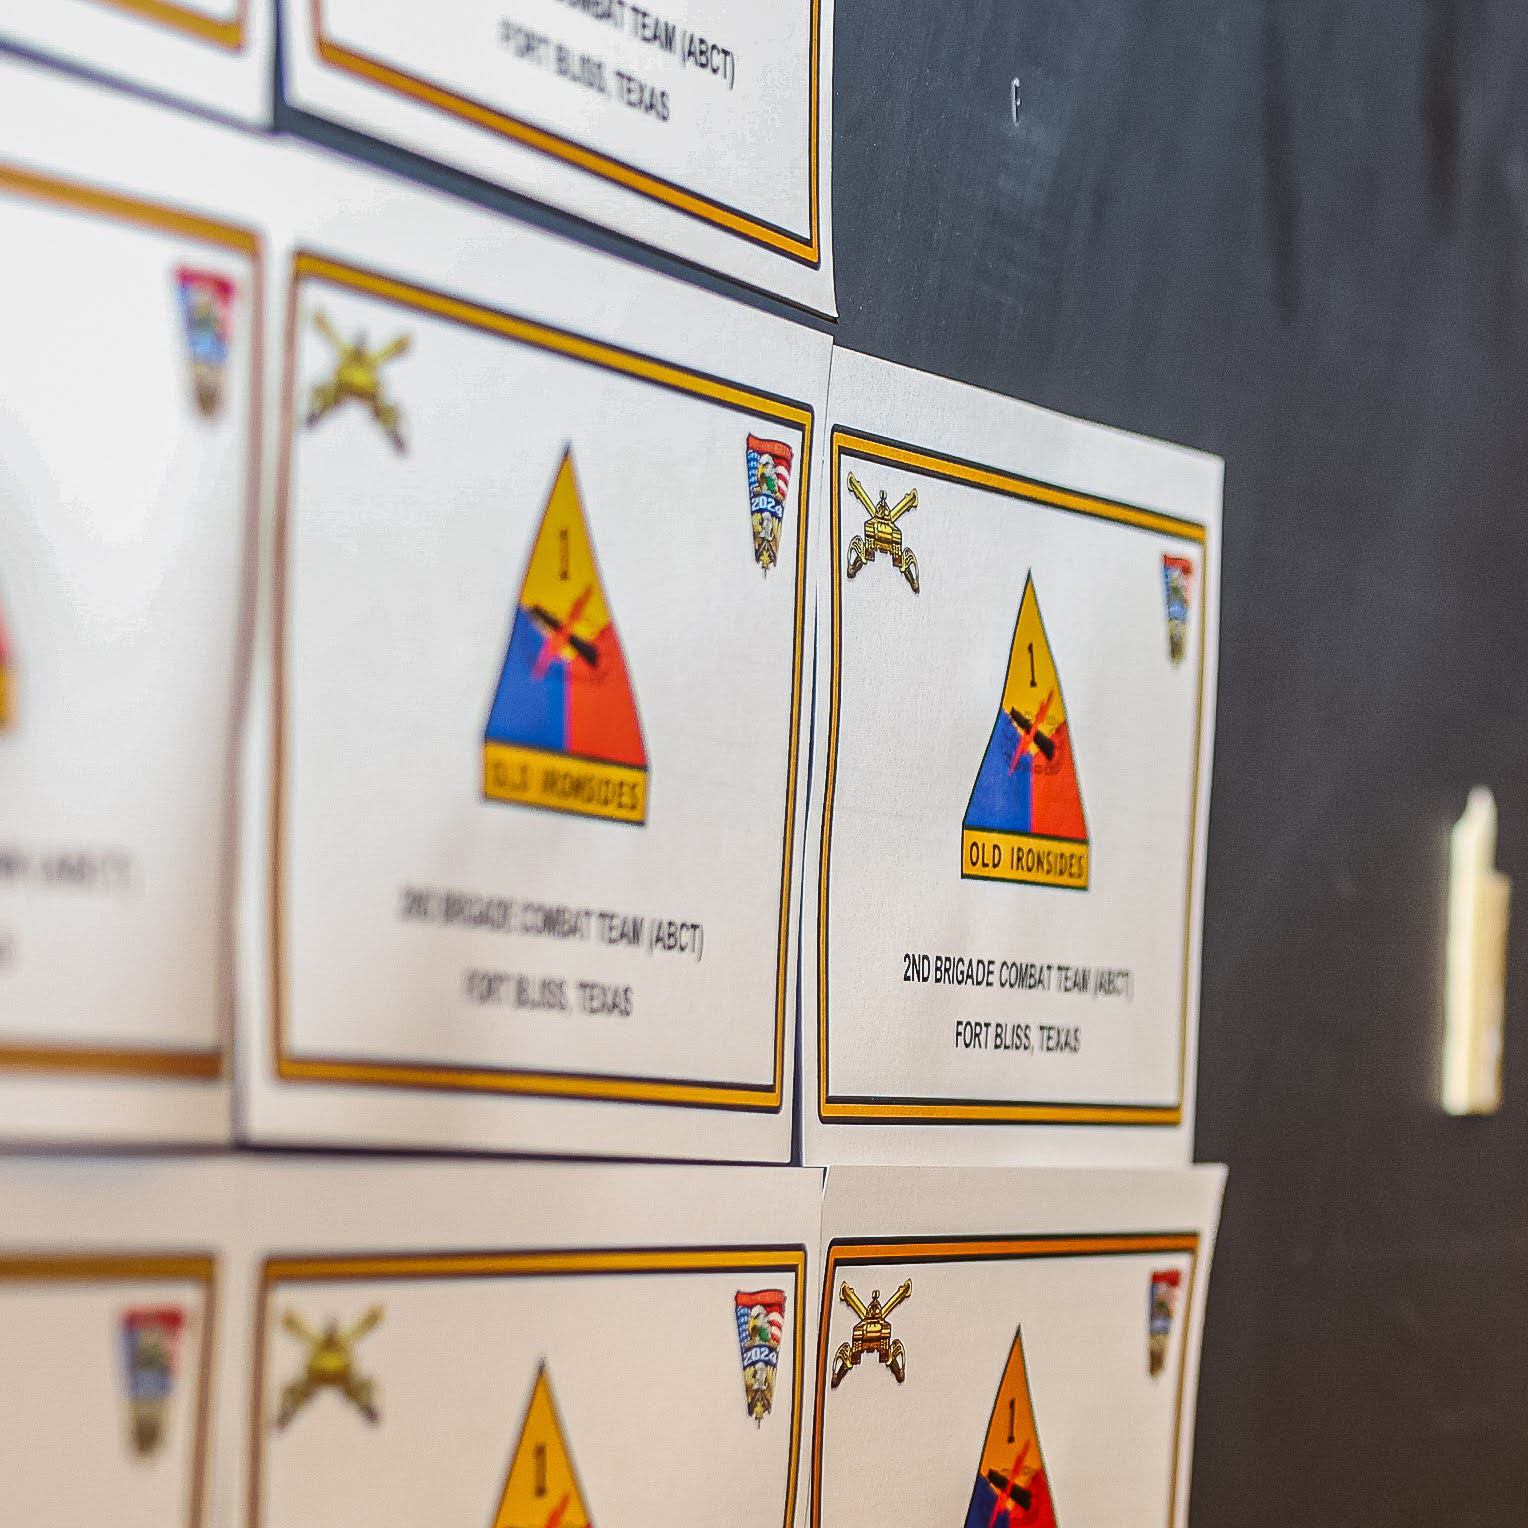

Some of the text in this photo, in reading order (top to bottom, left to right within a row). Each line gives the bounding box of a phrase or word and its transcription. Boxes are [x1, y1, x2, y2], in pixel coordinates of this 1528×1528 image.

[630, 5, 676, 54] TEAM
[680, 28, 735, 90] (ABCT)
[615, 69, 669, 121] TEXAS
[751, 495, 783, 519] 2024
[1027, 643, 1037, 687] 1
[970, 841, 1084, 880] OLD IRONSIDES
[597, 909, 644, 947] TEAM
[648, 916, 704, 963] (ABCT)
[903, 953, 930, 982] 2ND
[934, 956, 995, 987] BRIGADE
[999, 960, 1053, 992] COMBAT
[1057, 964, 1091, 994] TEAM
[955, 1021, 1081, 1055] FORT BLISS, TEXAS
[743, 1347, 777, 1365] 2024
[1008, 1398, 1016, 1444] 1
